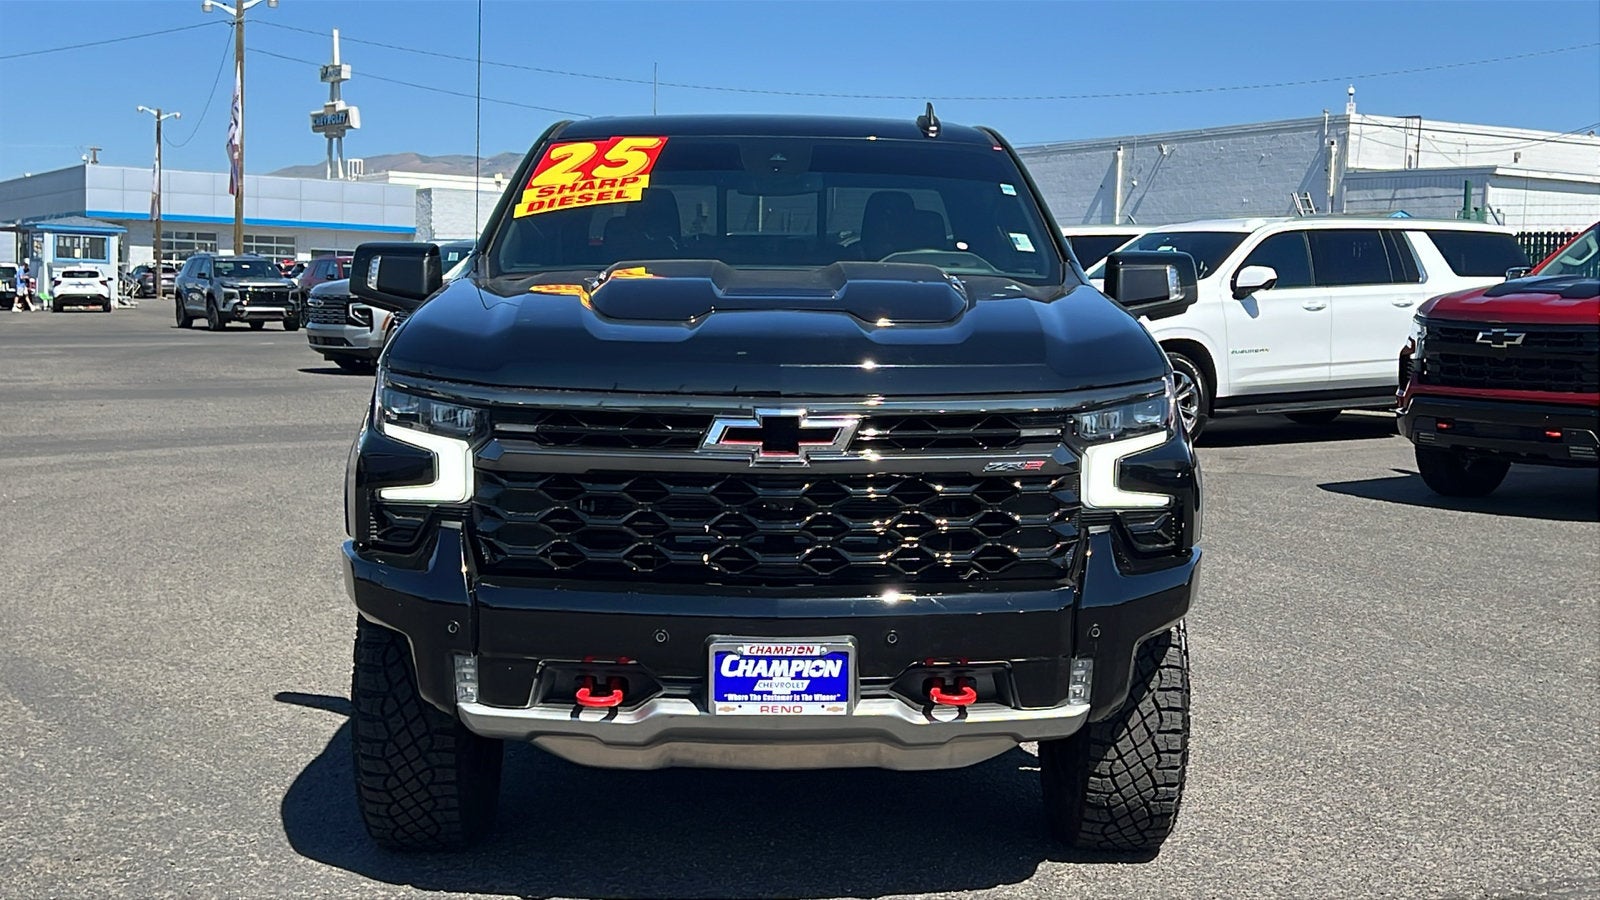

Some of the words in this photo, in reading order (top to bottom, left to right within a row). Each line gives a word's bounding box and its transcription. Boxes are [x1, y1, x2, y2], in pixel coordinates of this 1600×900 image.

[532, 137, 662, 187] 25
[536, 176, 641, 198] SHARP
[526, 189, 630, 213] DIESEL
[983, 461, 1046, 473] ZR2
[748, 646, 815, 655] CHAMPION
[720, 654, 843, 678] CHAMPION
[758, 681, 805, 689] CHEVROLET
[759, 705, 804, 714] RENO
